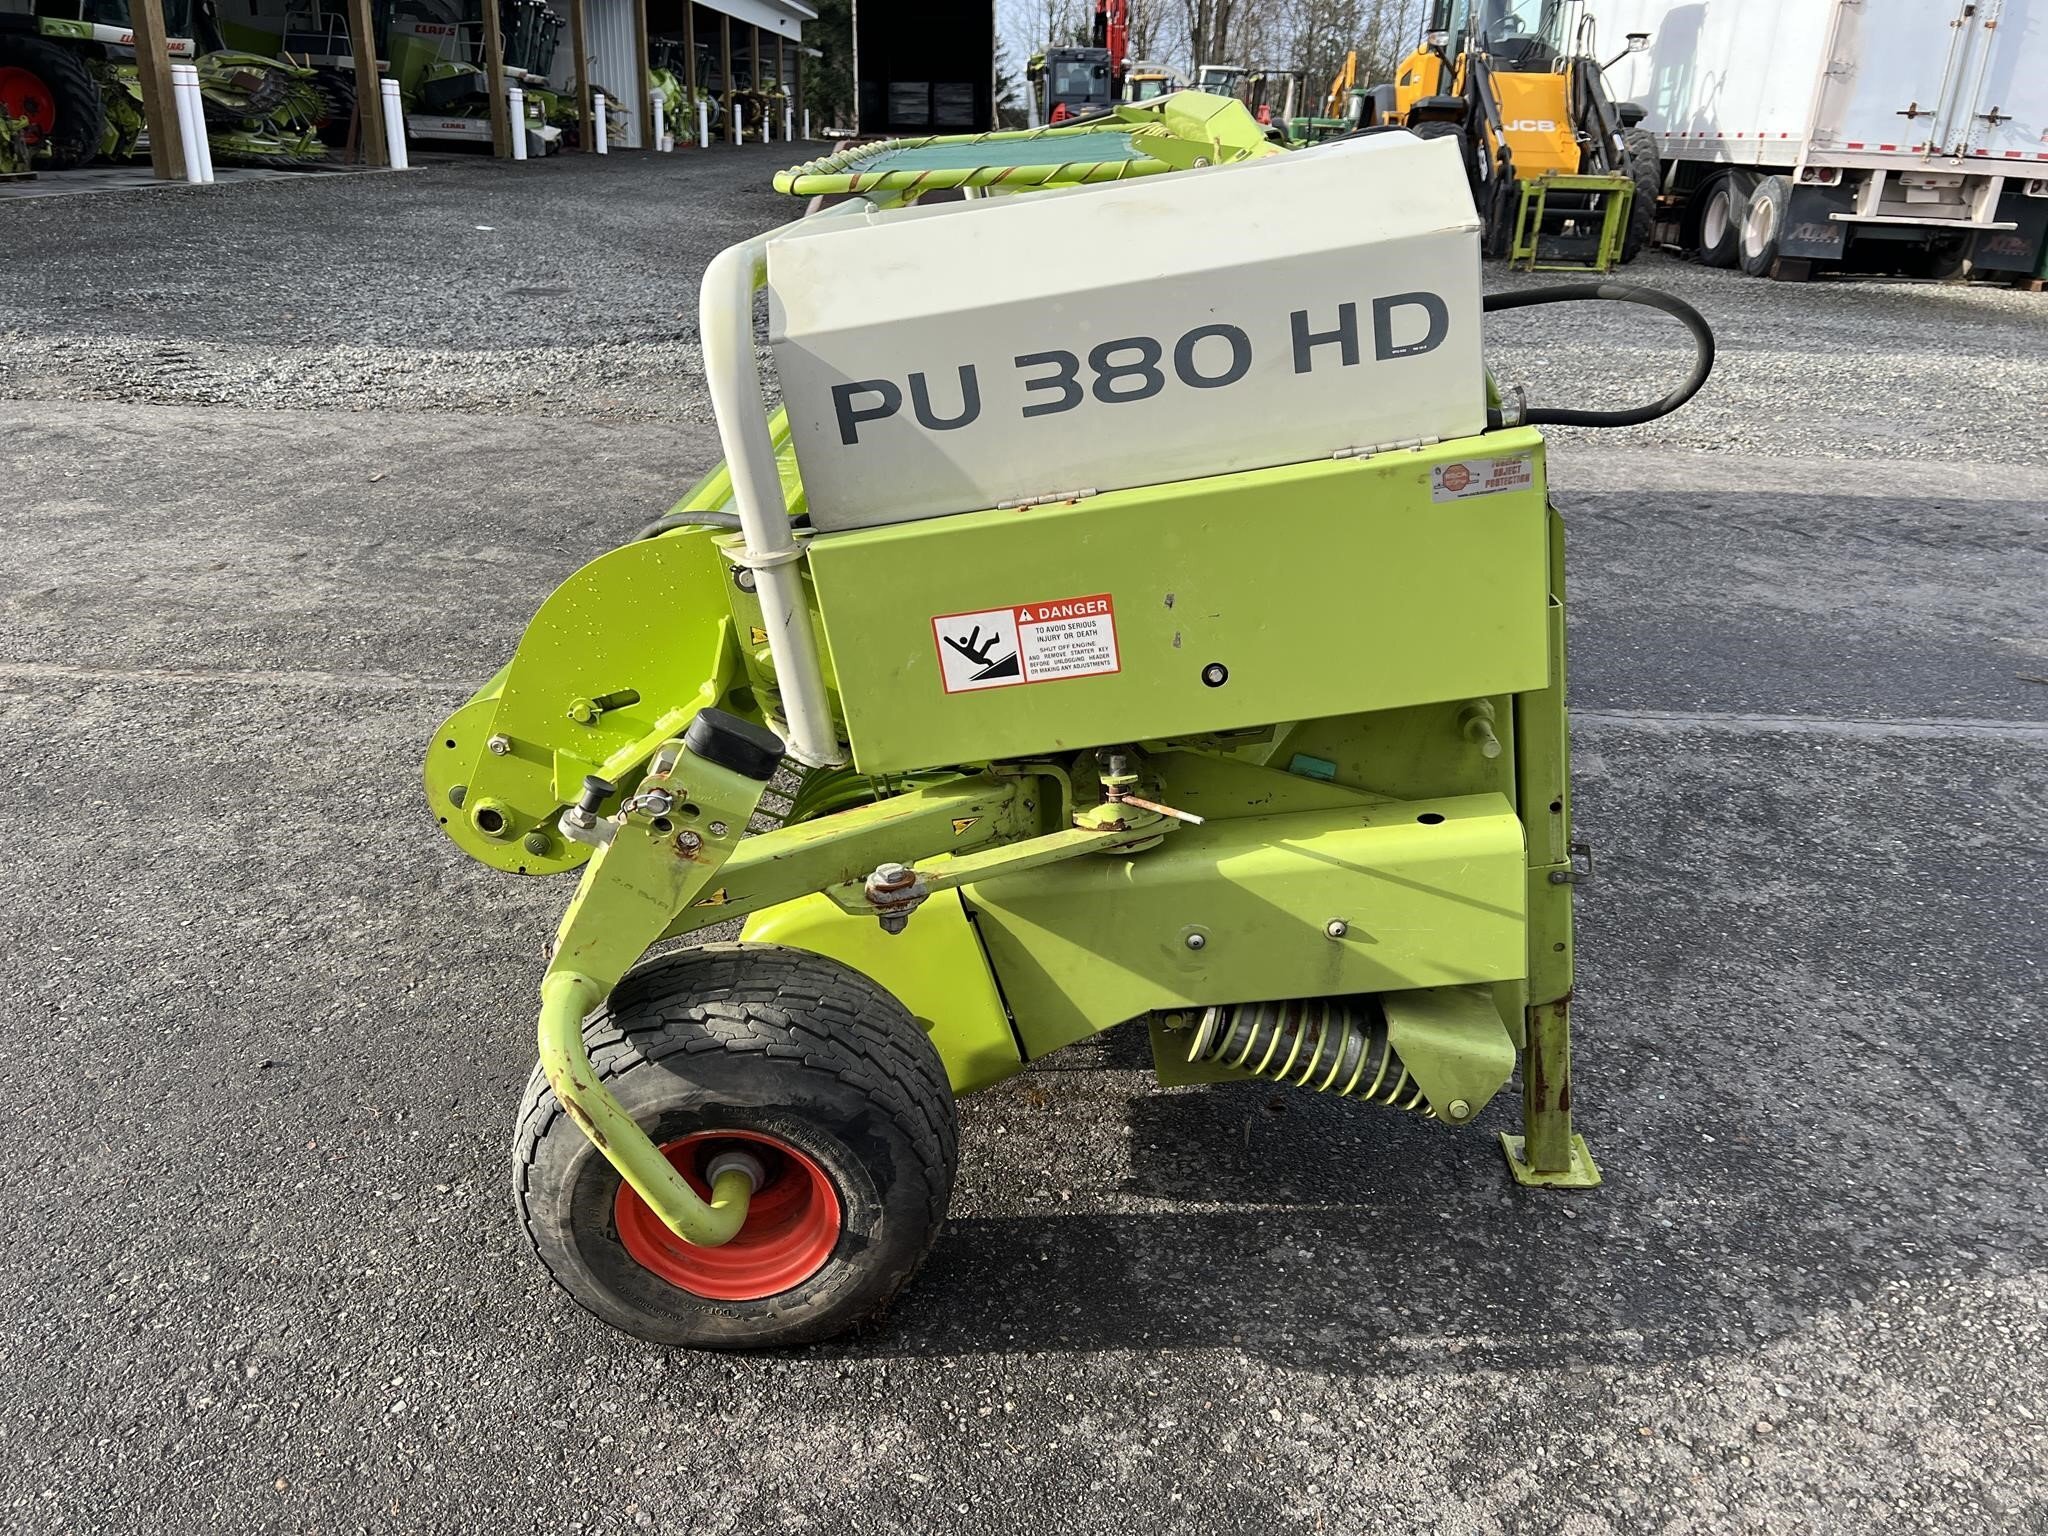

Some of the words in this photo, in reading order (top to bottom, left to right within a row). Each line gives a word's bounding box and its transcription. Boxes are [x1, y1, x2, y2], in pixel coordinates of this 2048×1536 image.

[167, 42, 186, 52] LAAS
[1503, 119, 1556, 132] JCB
[831, 363, 982, 446] PU
[1014, 323, 1253, 419] 380
[1290, 291, 1450, 375] HD
[1039, 600, 1108, 620] DANGER
[1046, 624, 1066, 633] AVOID
[1067, 621, 1097, 630] SERIOUS
[1036, 633, 1061, 643] INJURY
[1076, 629, 1098, 637] DEATH
[1072, 641, 1096, 649] ENGINE
[1030, 660, 1050, 668] BEFORE
[1073, 660, 1111, 669] ADJUSTMENTS
